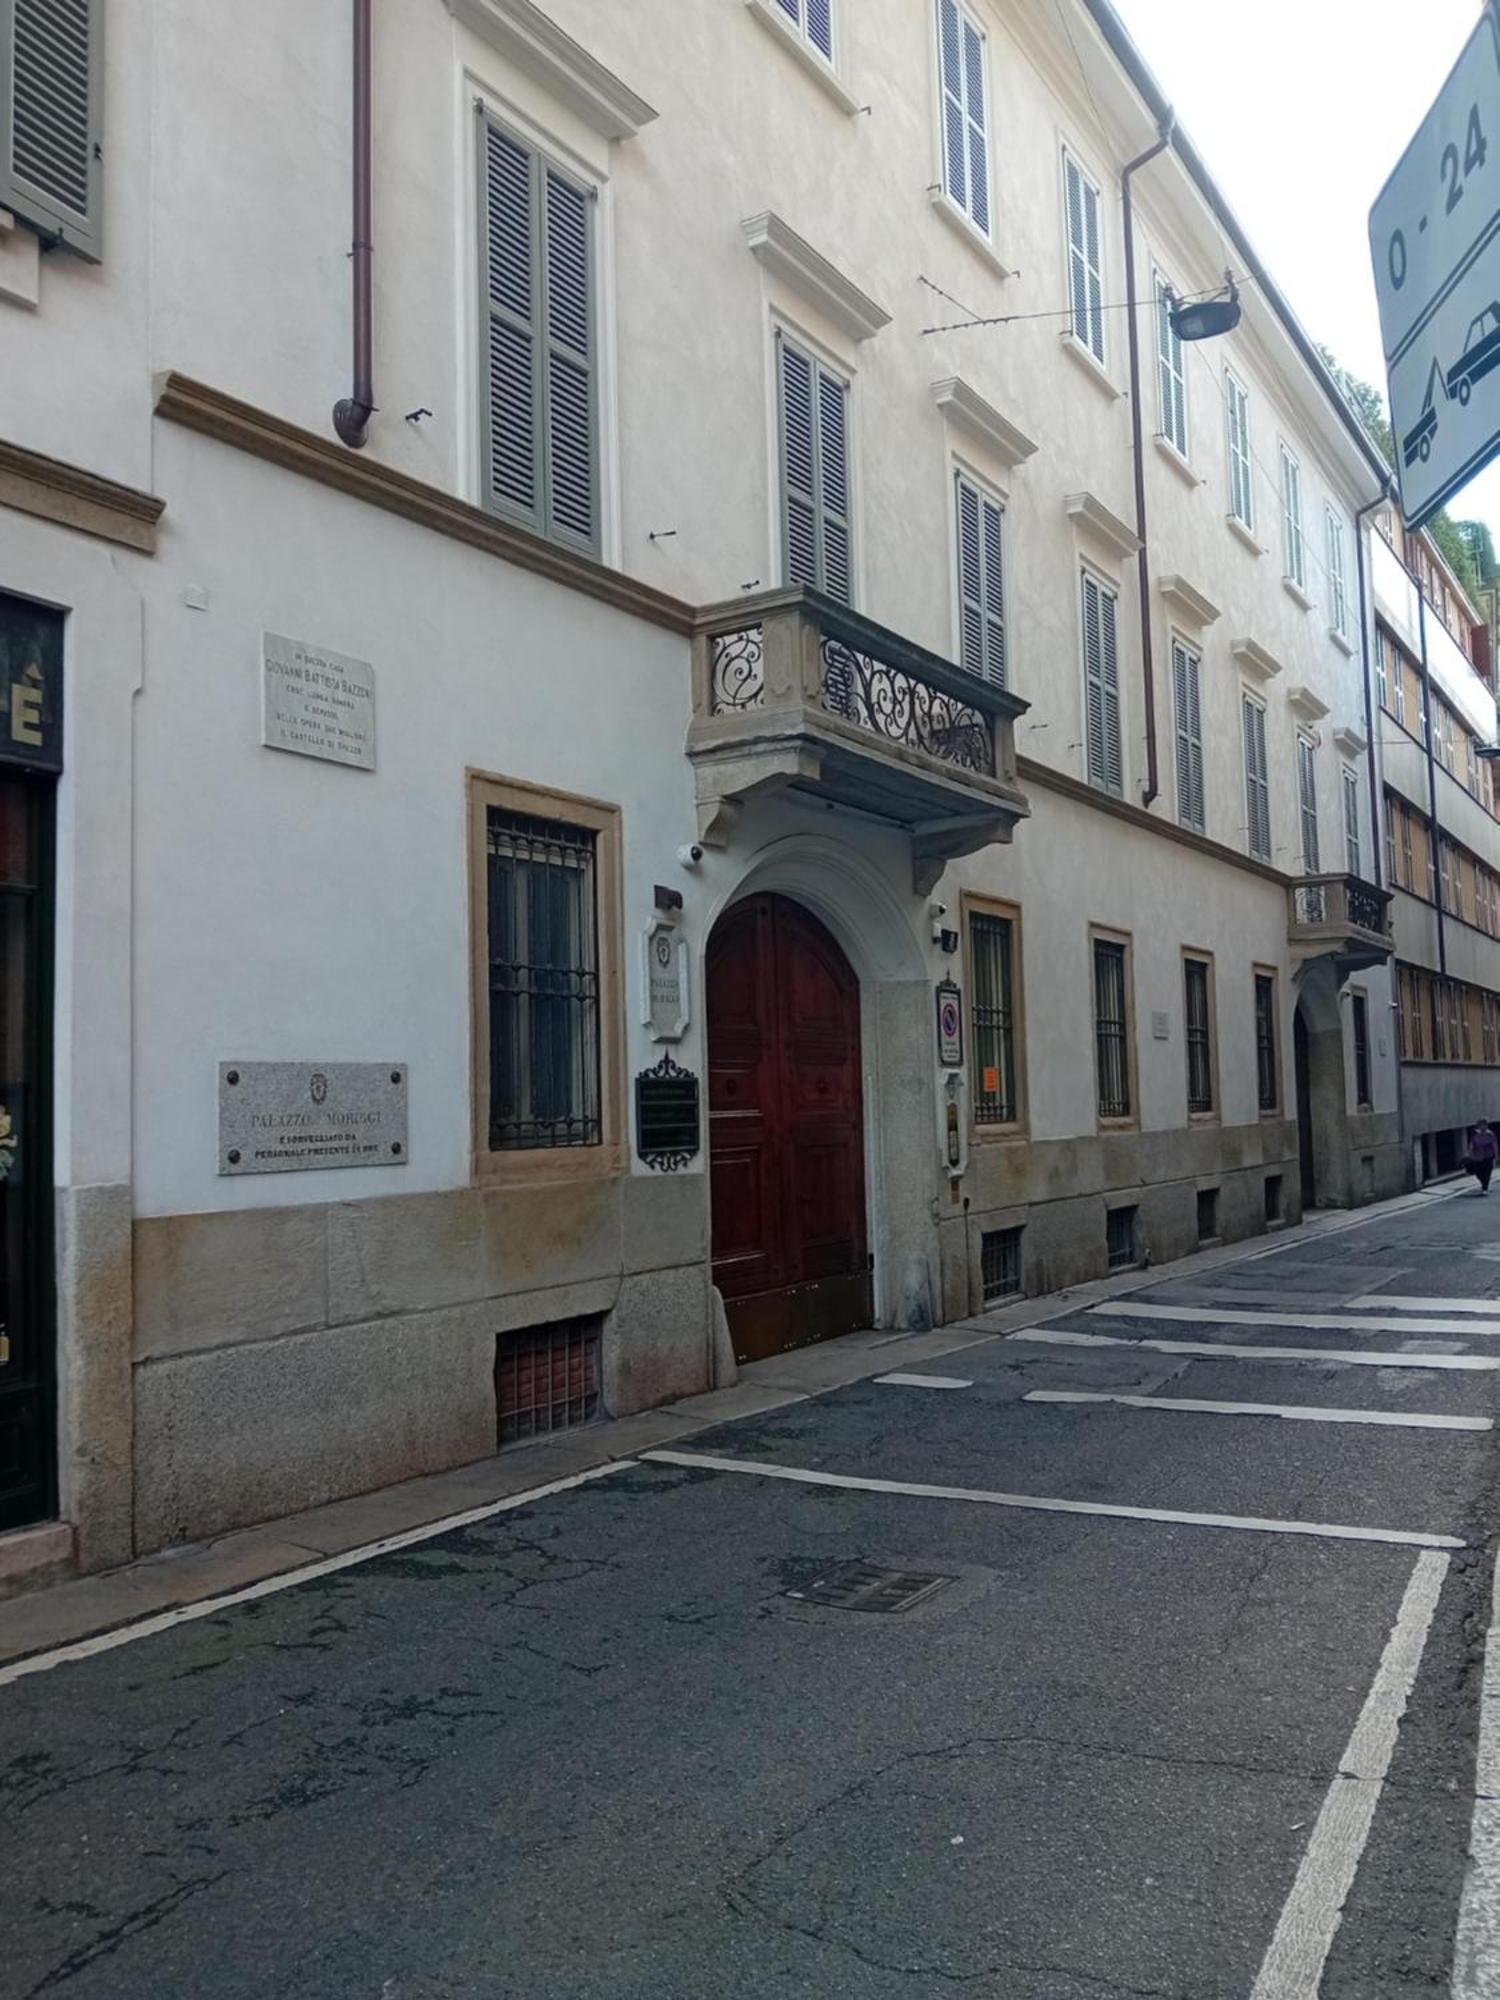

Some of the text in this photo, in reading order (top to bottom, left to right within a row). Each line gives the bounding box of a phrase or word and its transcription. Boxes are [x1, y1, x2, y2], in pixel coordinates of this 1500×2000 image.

[1440, 102, 1487, 216] 24
[289, 730, 325, 745] CASTELLO
[252, 1111, 381, 1128] PALAZZO MORIGGI
[345, 1133, 356, 1141] DA
[255, 1148, 305, 1159] PERSONALE
[308, 1146, 349, 1156] PRESENTE
